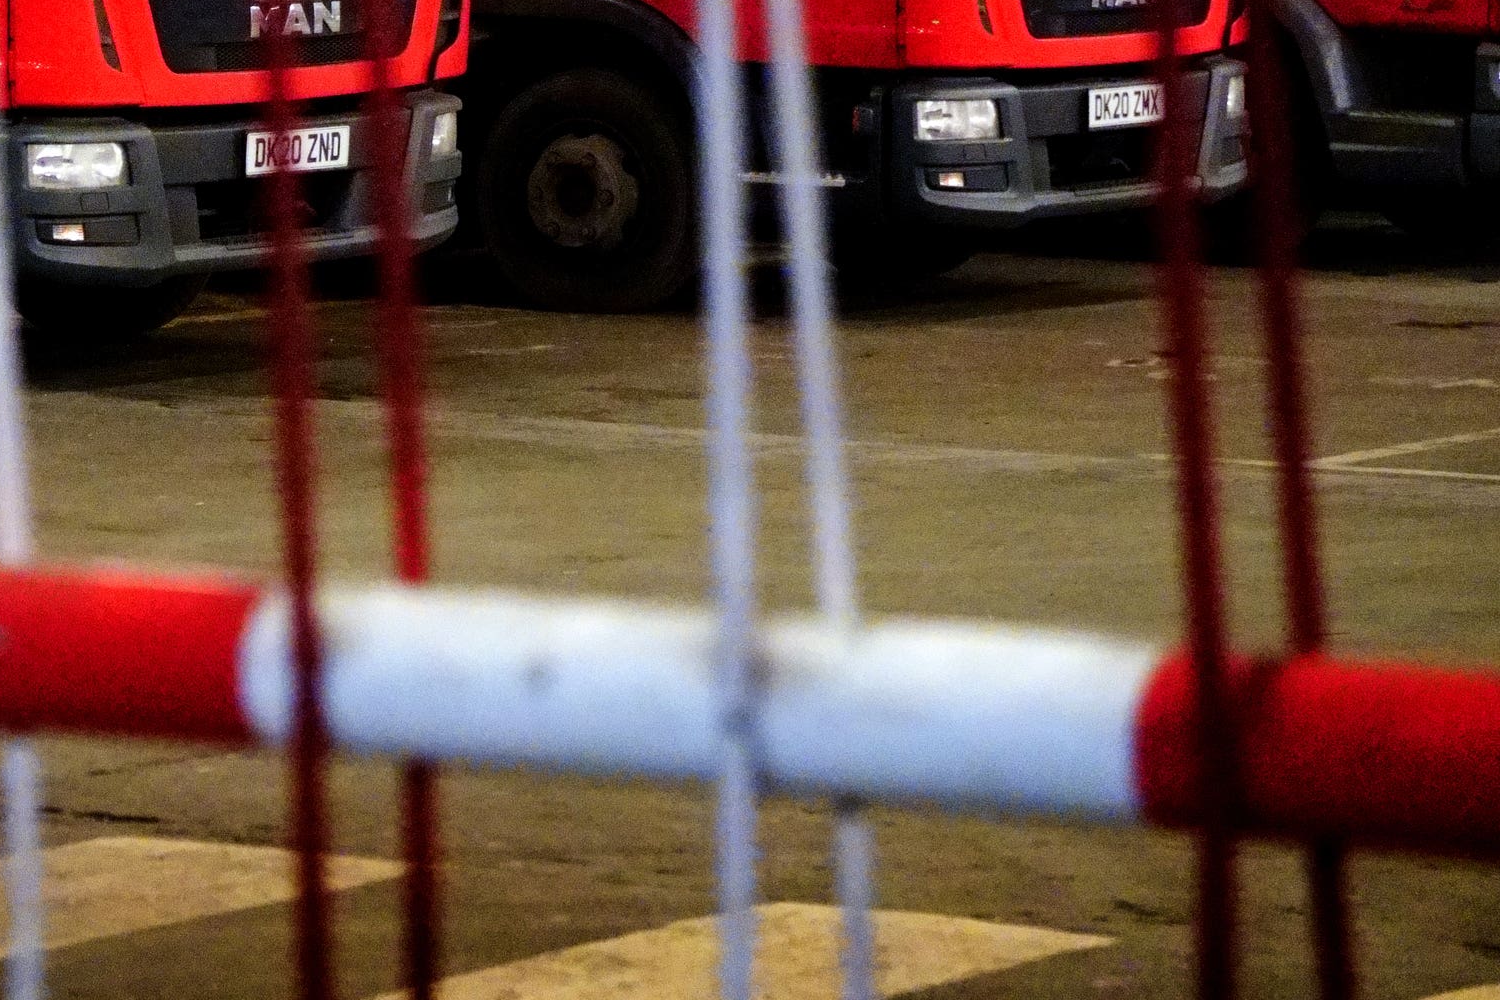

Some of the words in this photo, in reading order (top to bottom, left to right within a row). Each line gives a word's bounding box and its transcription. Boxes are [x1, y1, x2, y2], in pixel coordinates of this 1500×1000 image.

[250, 1, 341, 38] MAN
[1094, 91, 1130, 120] DK20
[306, 131, 342, 164] ZND
